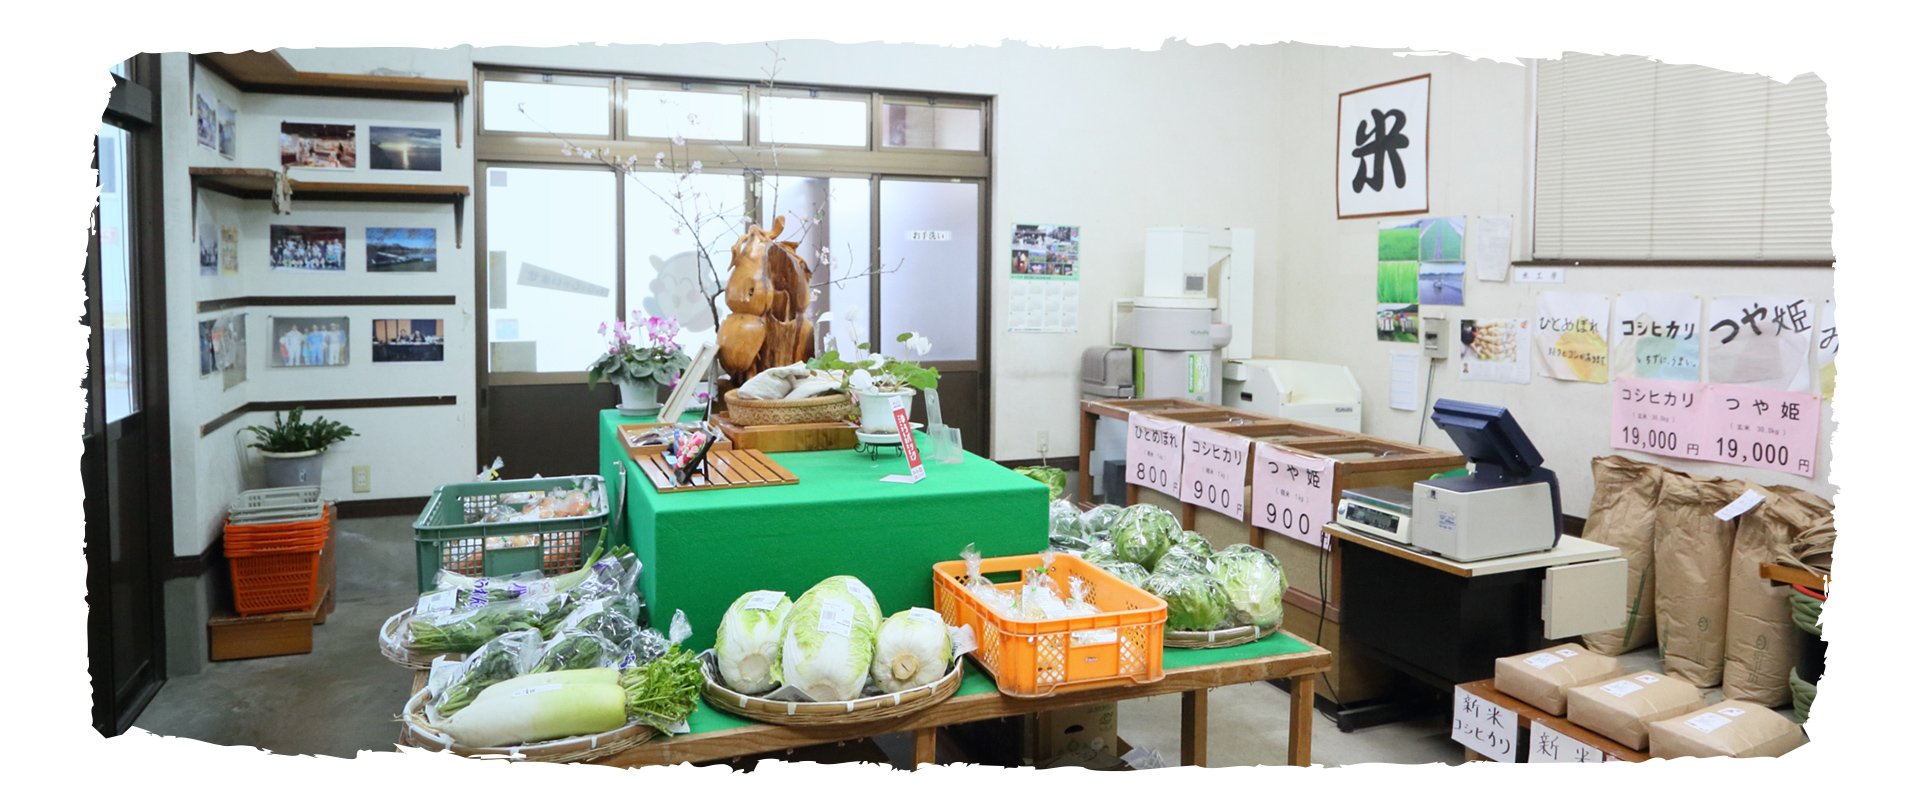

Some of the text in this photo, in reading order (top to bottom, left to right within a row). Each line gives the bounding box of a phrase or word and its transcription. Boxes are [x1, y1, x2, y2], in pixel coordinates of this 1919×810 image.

[1352, 108, 1410, 193] 米
[1540, 316, 1600, 334] ひとめぼれ
[1622, 320, 1696, 340] コシヒカリ
[1709, 299, 1812, 345] つや姫
[1622, 388, 1694, 408] コシヒカリ
[1726, 398, 1801, 421] つや姫
[1192, 440, 1242, 466] コシヒカリ
[1622, 425, 1700, 456] 19,000 円
[1716, 437, 1810, 473] 19,000 円
[1136, 462, 1168, 488] 800
[1268, 461, 1321, 489] つや姫
[1194, 480, 1230, 509] 900
[1266, 503, 1310, 535] 900
[1462, 694, 1505, 729] 新米
[1454, 719, 1511, 755] コシヒカリ
